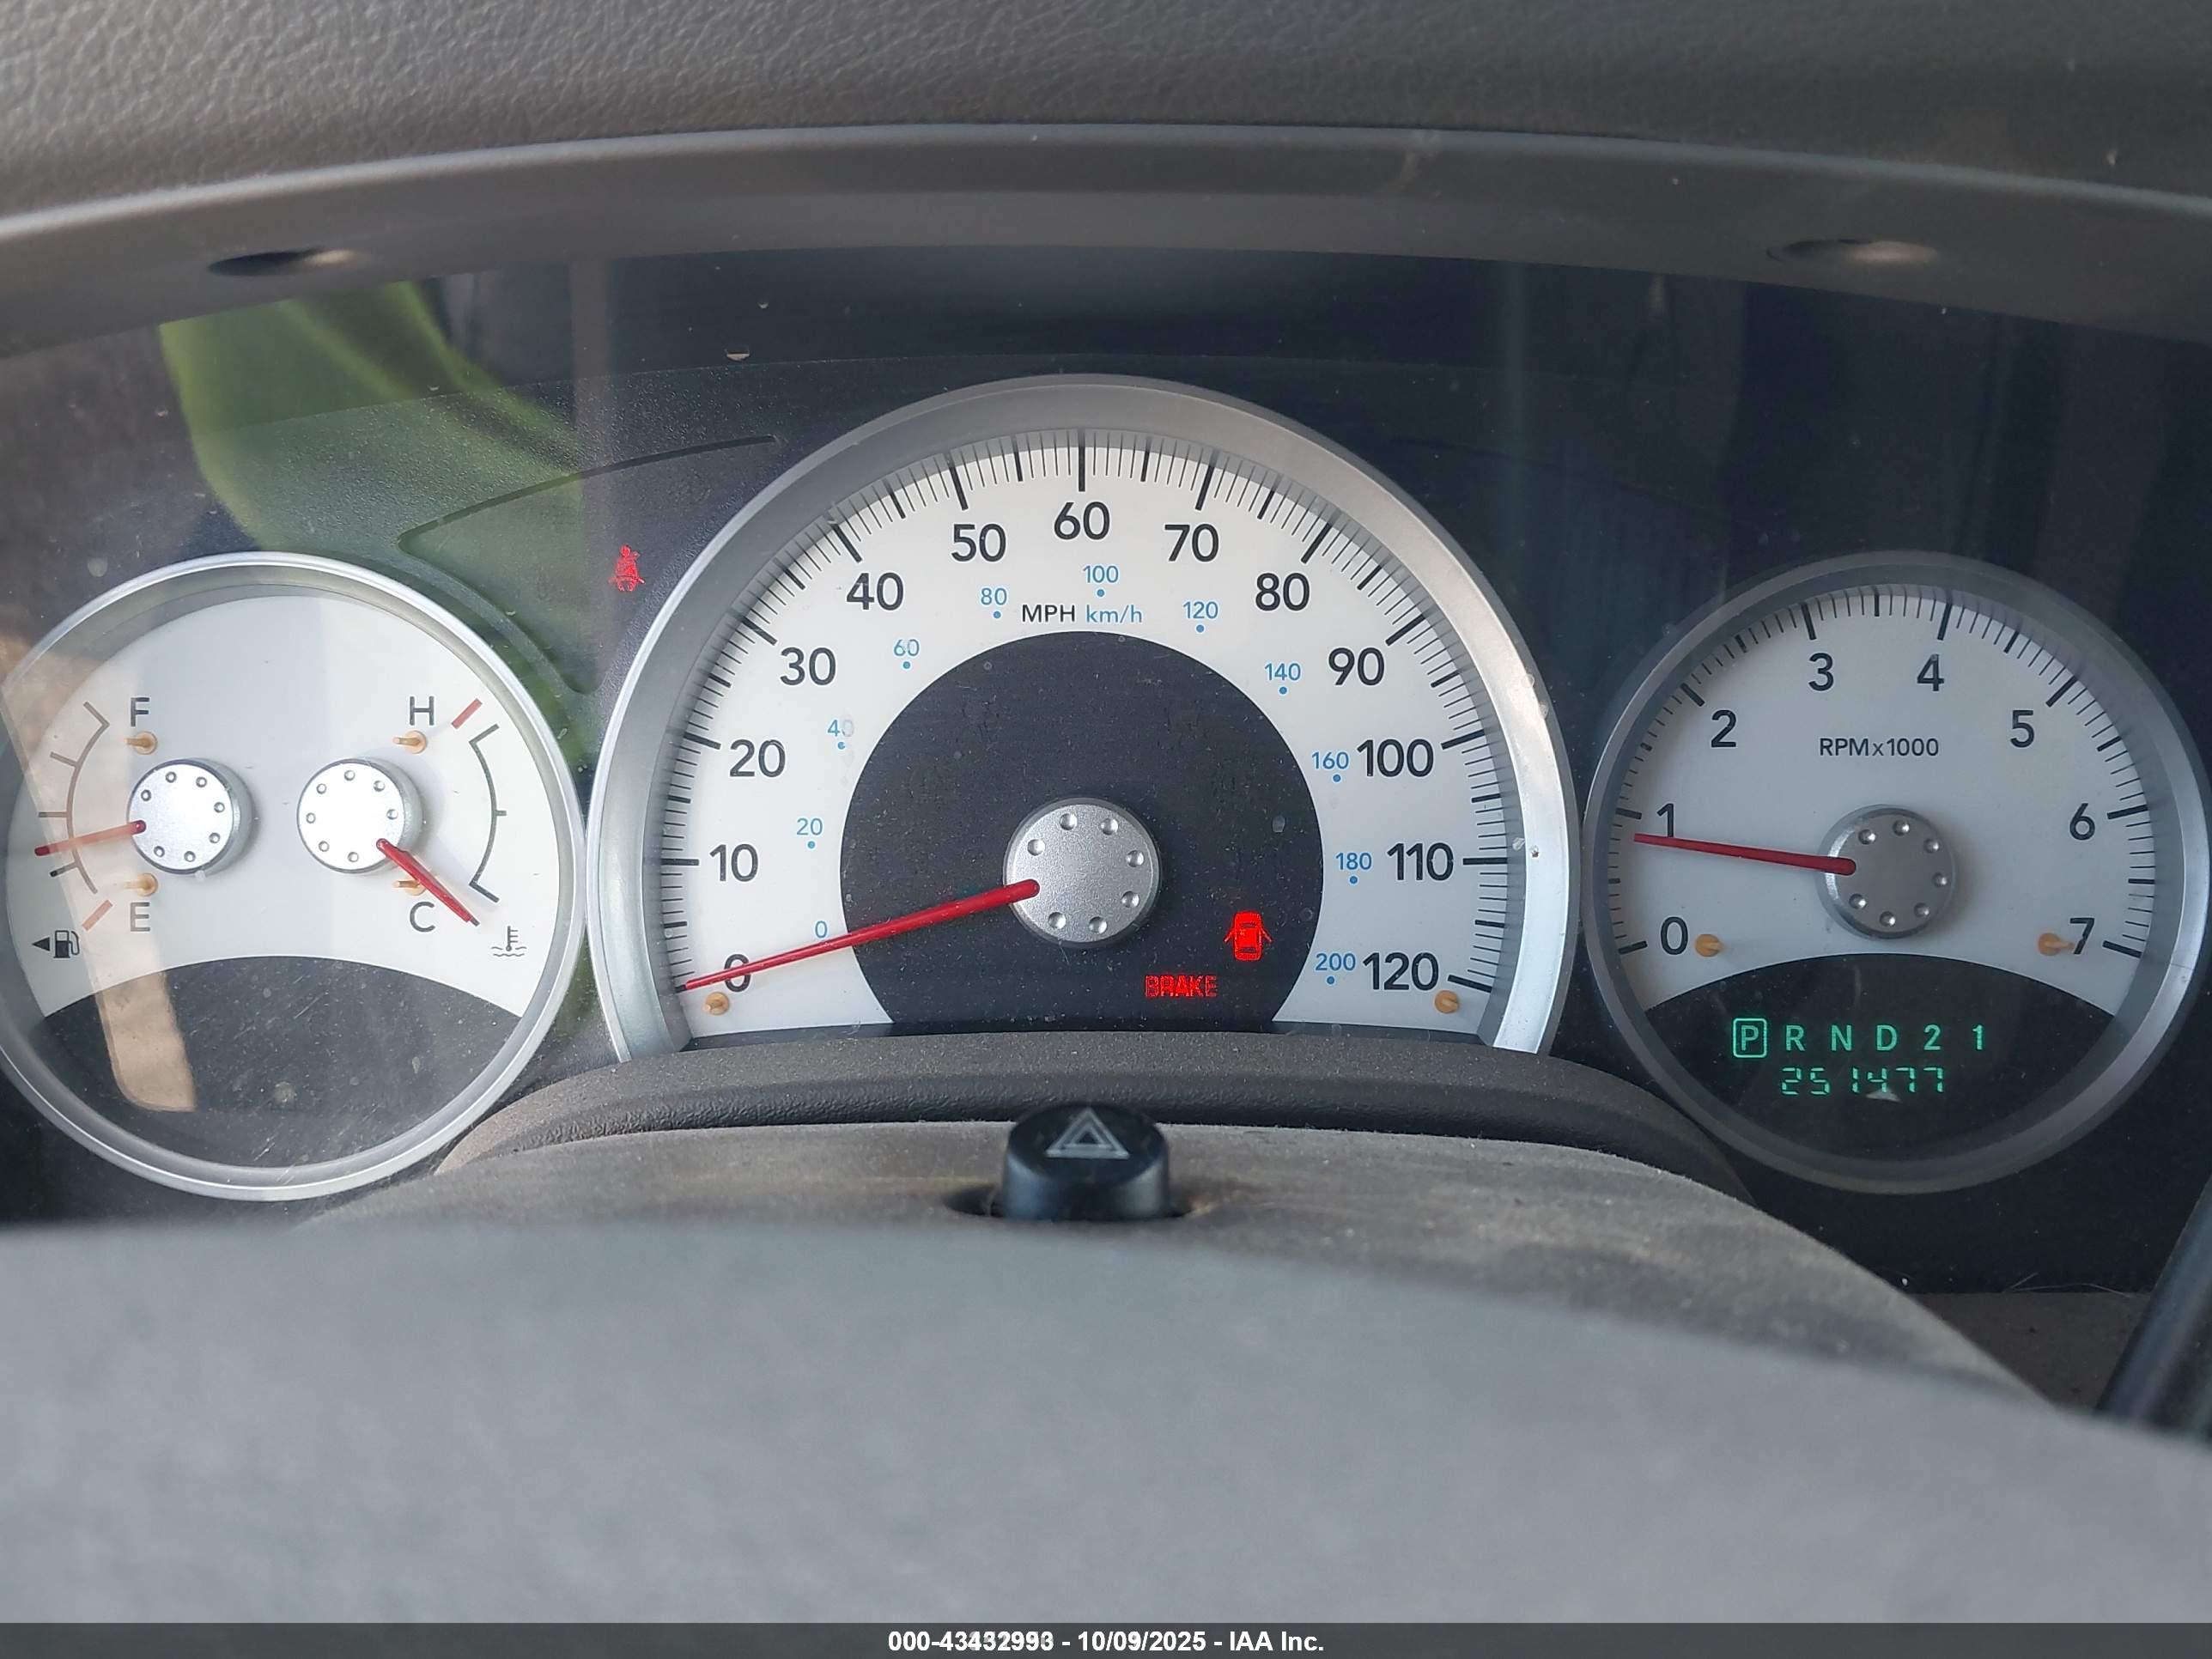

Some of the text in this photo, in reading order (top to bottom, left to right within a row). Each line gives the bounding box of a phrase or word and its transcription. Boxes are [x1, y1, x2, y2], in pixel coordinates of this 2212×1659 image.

[1054, 501, 1109, 539] 60
[952, 524, 1006, 562] 50
[1165, 524, 1218, 562] 70
[847, 573, 903, 611] 40
[1084, 565, 1119, 584] 100
[1256, 573, 1310, 611] 80
[981, 587, 1006, 605] 80
[1184, 602, 1218, 619] 120
[1023, 605, 1143, 624] MPH km/h
[781, 647, 836, 685] 30
[893, 639, 920, 657] 60
[1328, 647, 1384, 685] 90
[1265, 662, 1301, 682] 140
[1809, 653, 1833, 690] 3
[1917, 654, 1944, 691] 4
[131, 697, 150, 726] F
[410, 696, 434, 726] H
[1711, 710, 1736, 747] 2
[2011, 710, 2034, 747] 5
[730, 739, 785, 777] 20
[1312, 751, 1348, 770] 160
[1358, 739, 1433, 776] 100
[797, 817, 823, 836] 20
[1656, 804, 1675, 837] 1
[2070, 803, 2095, 840] 6
[710, 844, 757, 882] 10
[1336, 852, 1372, 871] 180
[1388, 843, 1453, 880] 110
[131, 902, 150, 932] E
[410, 902, 434, 932] C
[815, 921, 828, 939] 0
[1661, 918, 1687, 954] 0
[2070, 918, 2094, 954] 7
[724, 954, 751, 992] 0
[1316, 953, 1355, 972] 200
[1364, 952, 1438, 990] 120
[1145, 975, 1217, 997] BRAKE
[1741, 1025, 1984, 1050] P R N D 2 1
[1782, 1067, 1944, 1095] 251477
